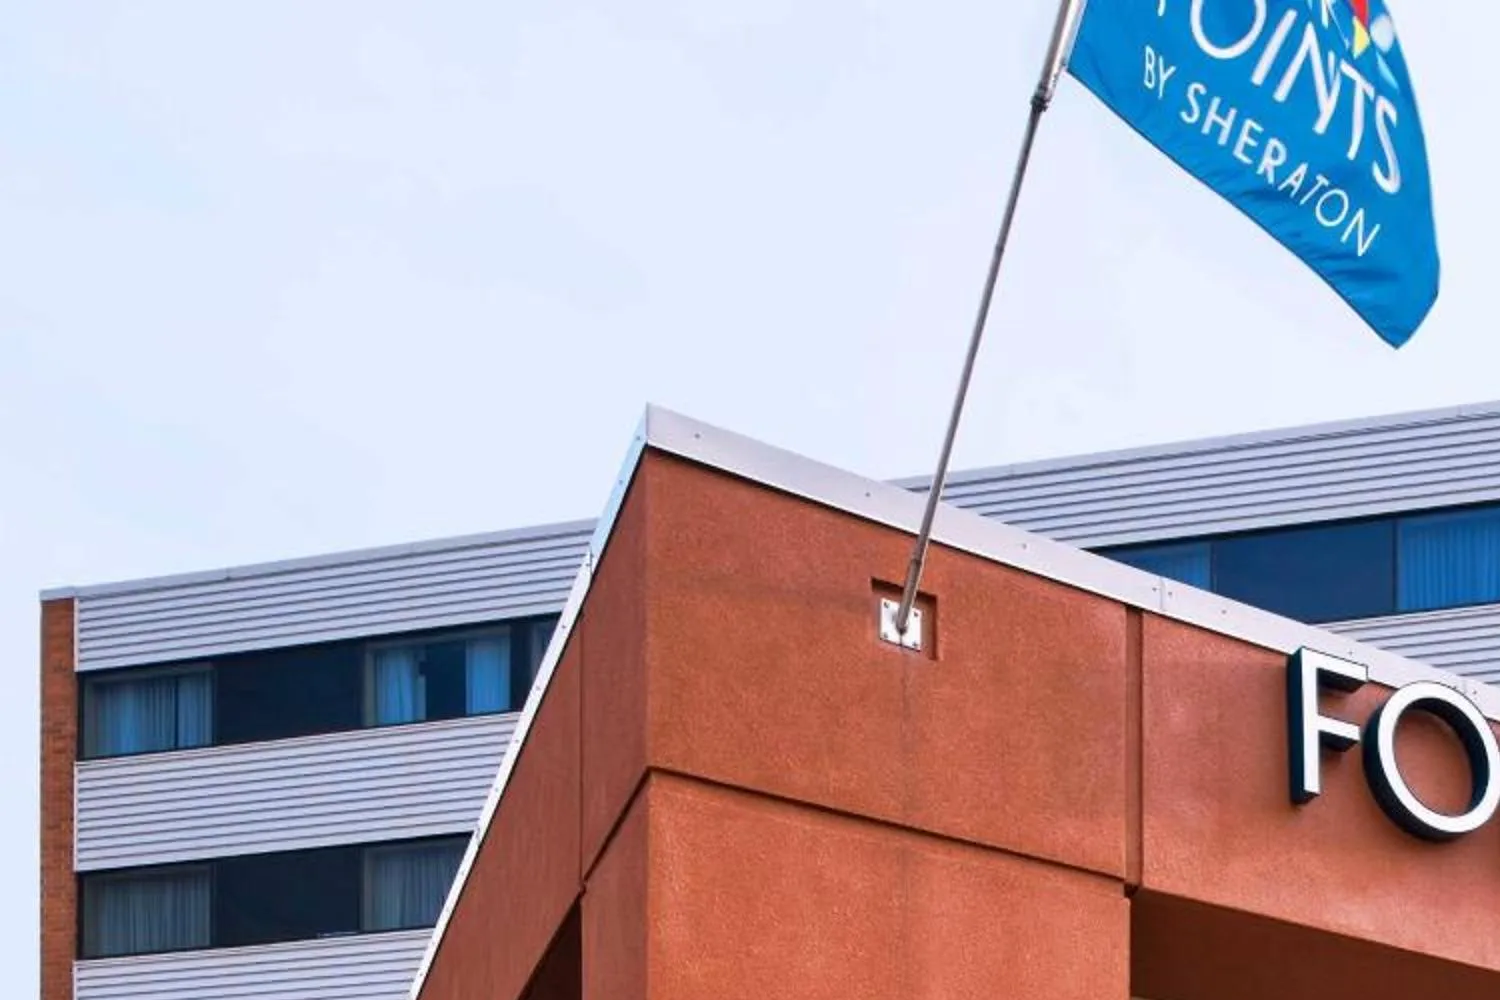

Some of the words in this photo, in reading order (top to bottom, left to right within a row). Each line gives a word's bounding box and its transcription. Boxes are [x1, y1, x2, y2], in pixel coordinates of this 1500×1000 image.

[1143, 45, 1176, 99] BY
[1180, 82, 1381, 257] SHERATON
[1157, 0, 1400, 194] OINTS
